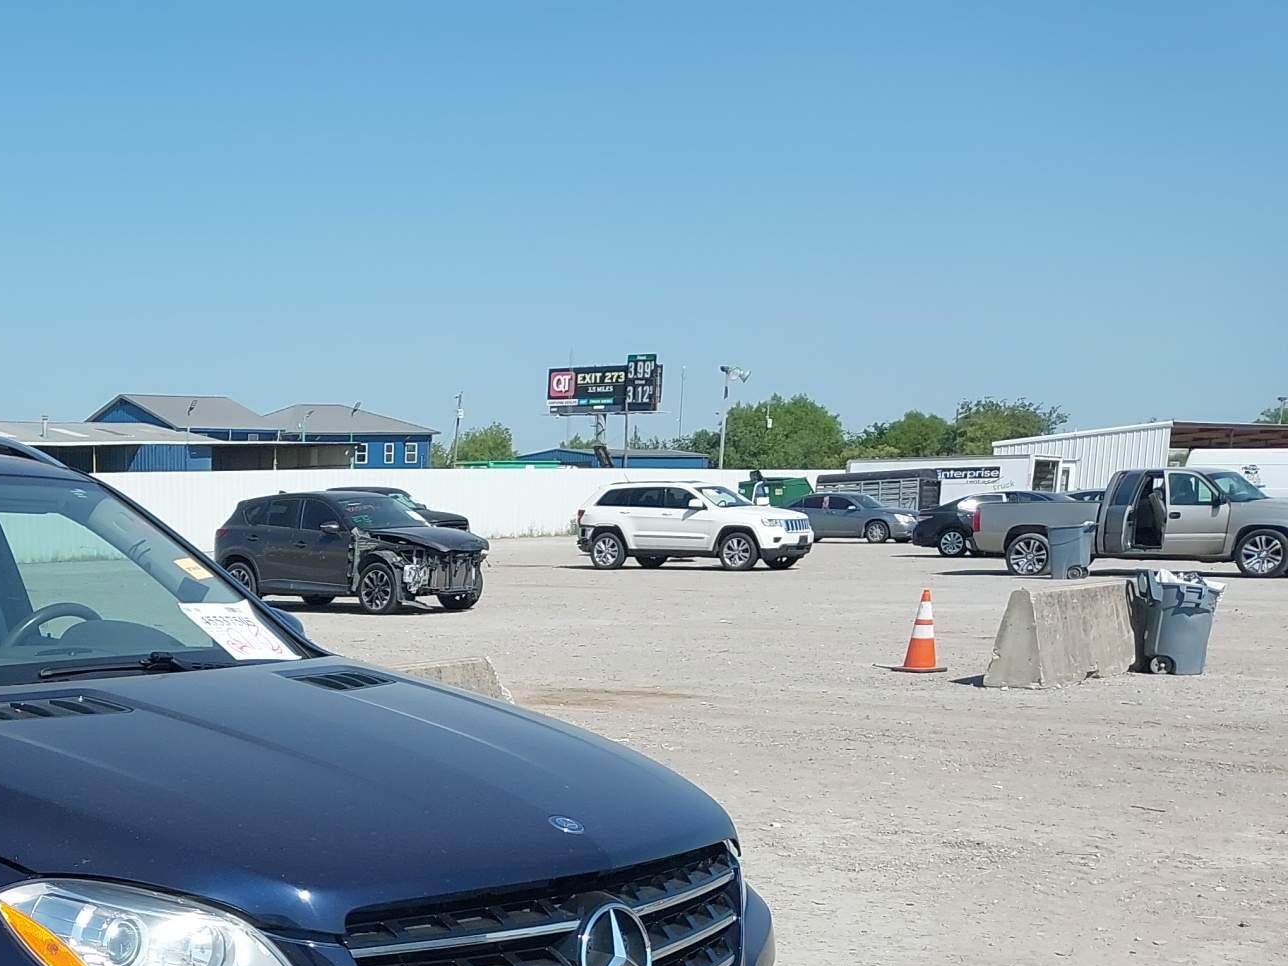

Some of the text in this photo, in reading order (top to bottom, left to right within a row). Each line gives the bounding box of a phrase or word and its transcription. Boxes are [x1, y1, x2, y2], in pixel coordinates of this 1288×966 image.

[552, 374, 572, 393] QT
[577, 372, 602, 384] EXIT
[604, 371, 626, 383] 273
